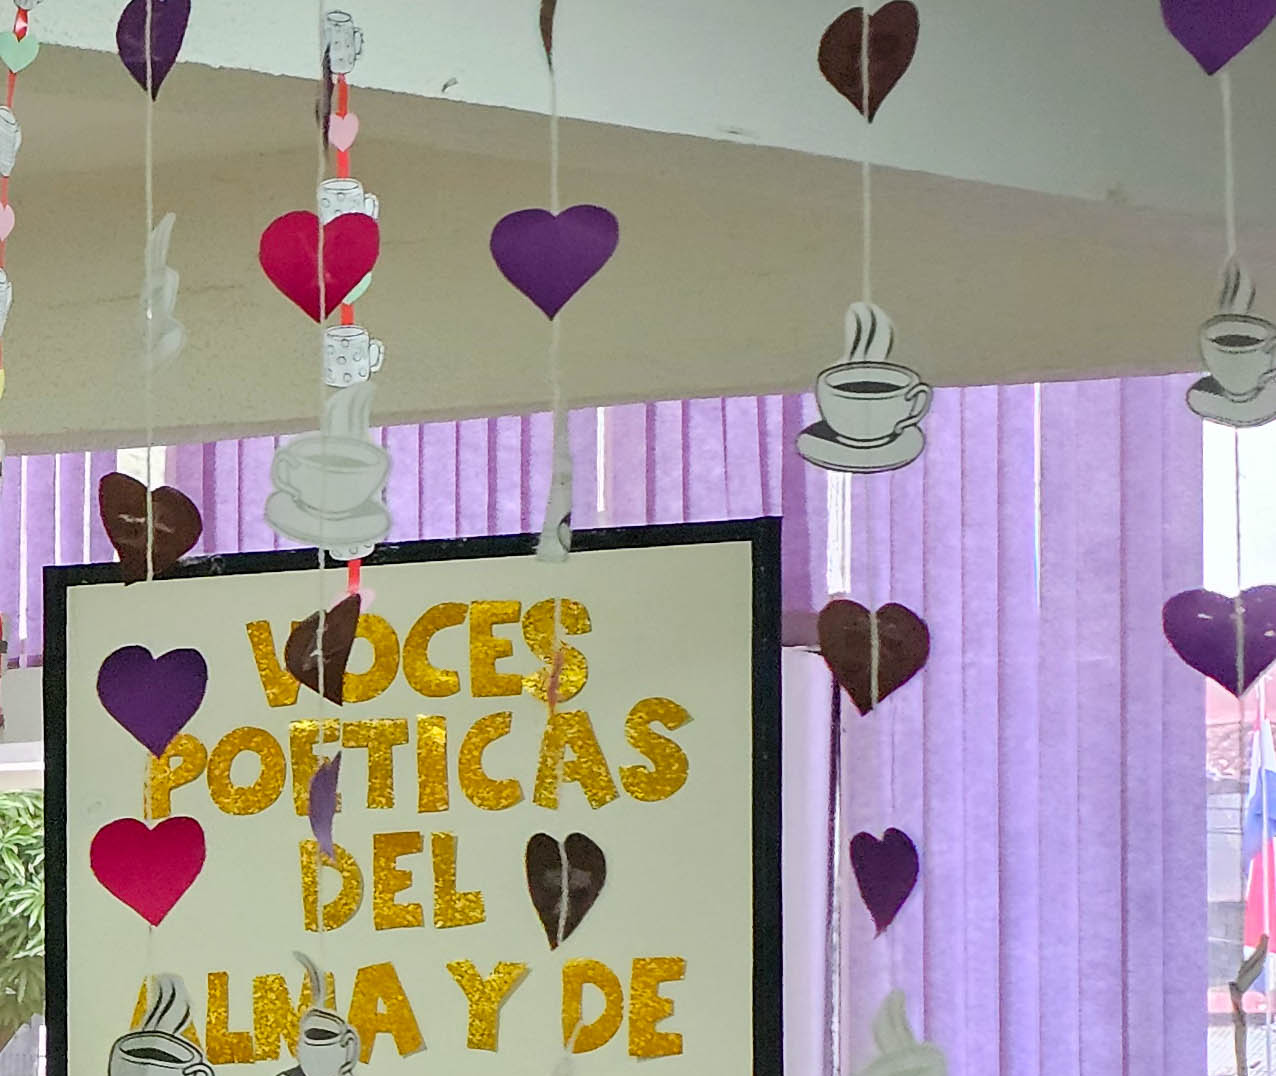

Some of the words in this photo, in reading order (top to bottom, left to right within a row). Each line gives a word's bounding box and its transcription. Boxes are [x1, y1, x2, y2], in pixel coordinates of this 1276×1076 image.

[246, 598, 592, 707] VOCES
[144, 697, 695, 820] POETICAS
[299, 831, 486, 932] DEL
[445, 959, 530, 1052] Y
[562, 957, 685, 1057] DE
